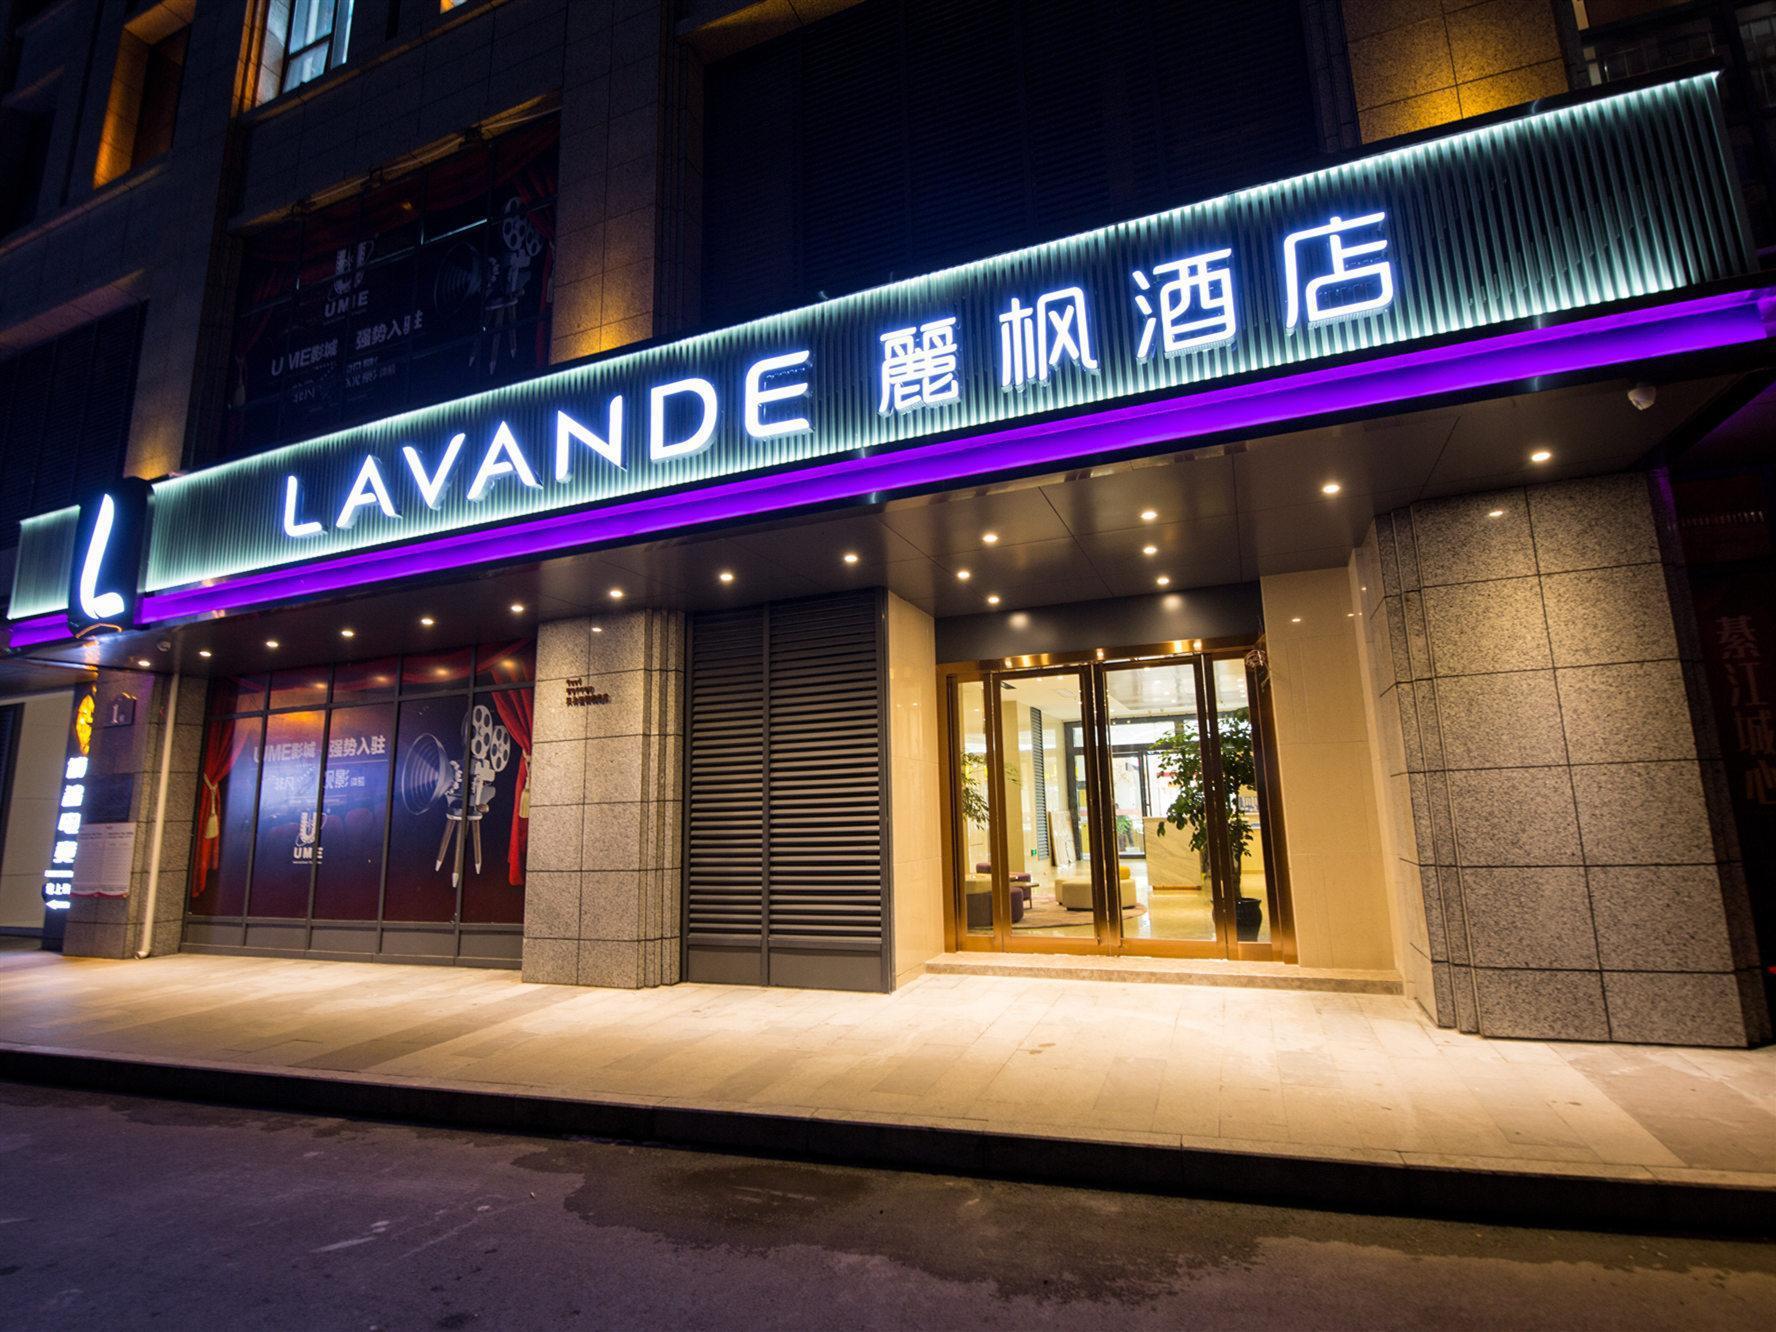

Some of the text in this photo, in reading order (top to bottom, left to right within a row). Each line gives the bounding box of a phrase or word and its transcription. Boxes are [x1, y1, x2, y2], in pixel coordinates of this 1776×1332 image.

[878, 211, 1395, 414] 麗枫酒店
[283, 350, 812, 538] LAVANDE
[328, 735, 386, 758] 强势入驻
